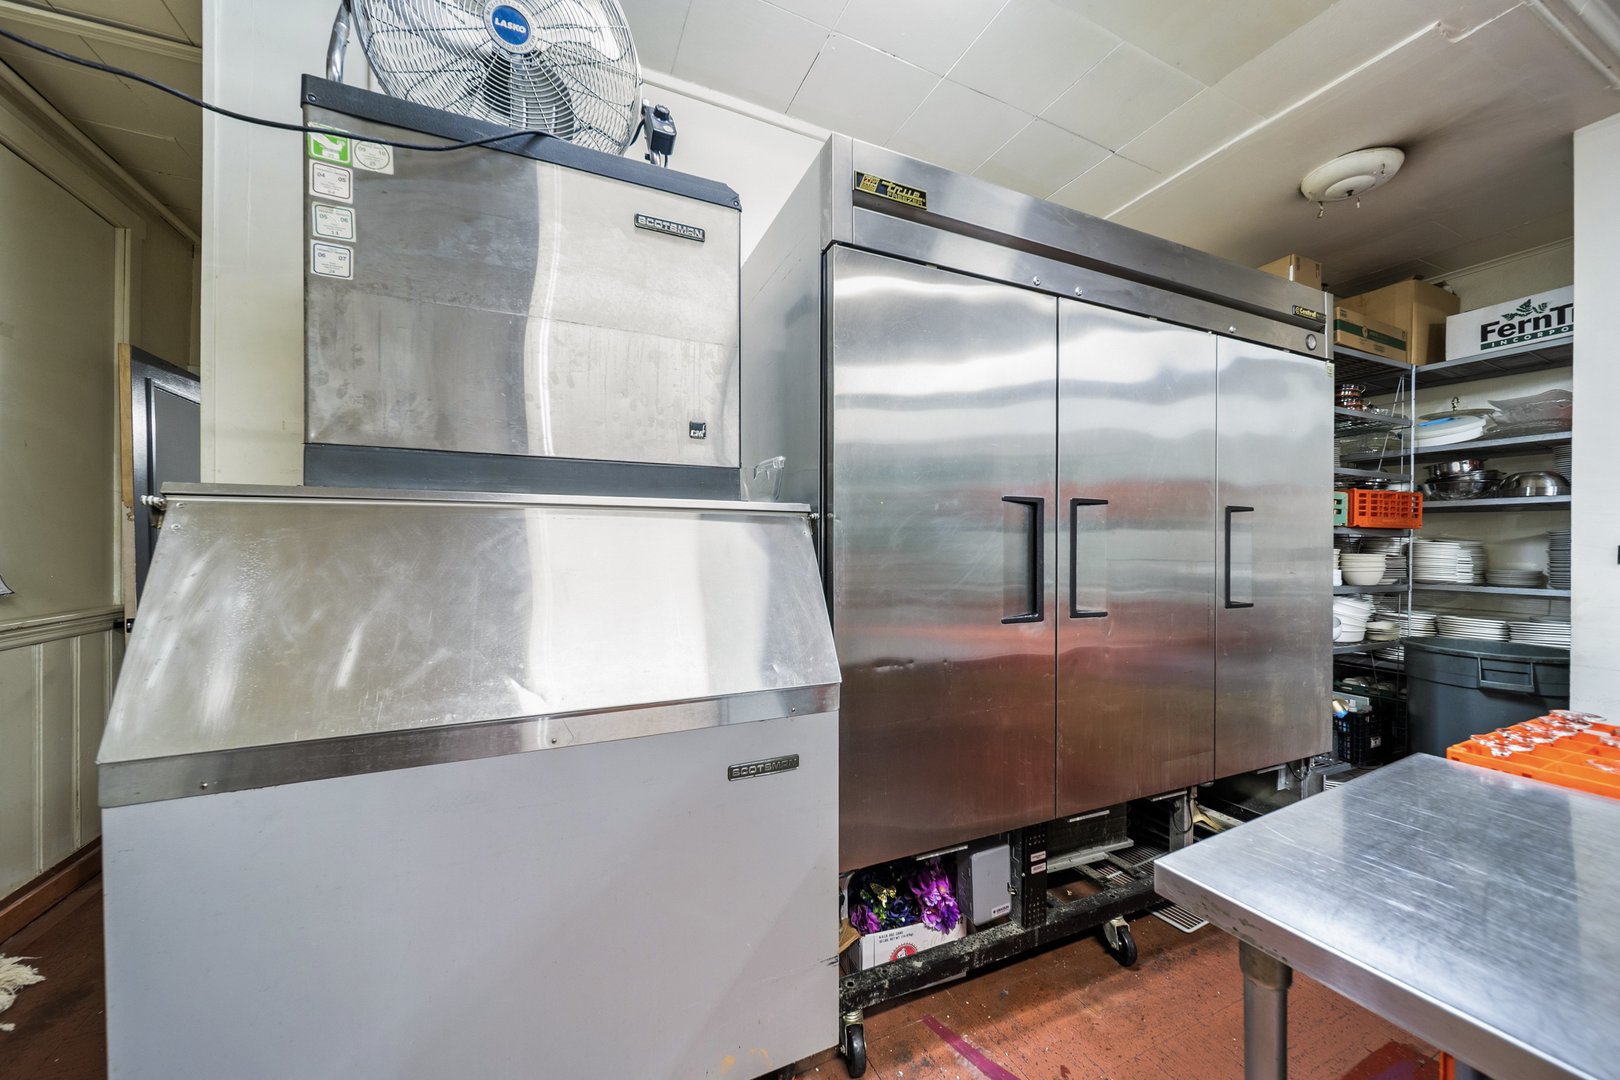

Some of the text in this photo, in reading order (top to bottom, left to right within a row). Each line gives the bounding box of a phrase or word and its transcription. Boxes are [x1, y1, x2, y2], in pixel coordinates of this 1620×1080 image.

[494, 17, 527, 33] LASKO
[637, 215, 704, 239] SCOTSMAN
[1480, 303, 1574, 343] FernT
[732, 758, 799, 777] SCOTSMAN
